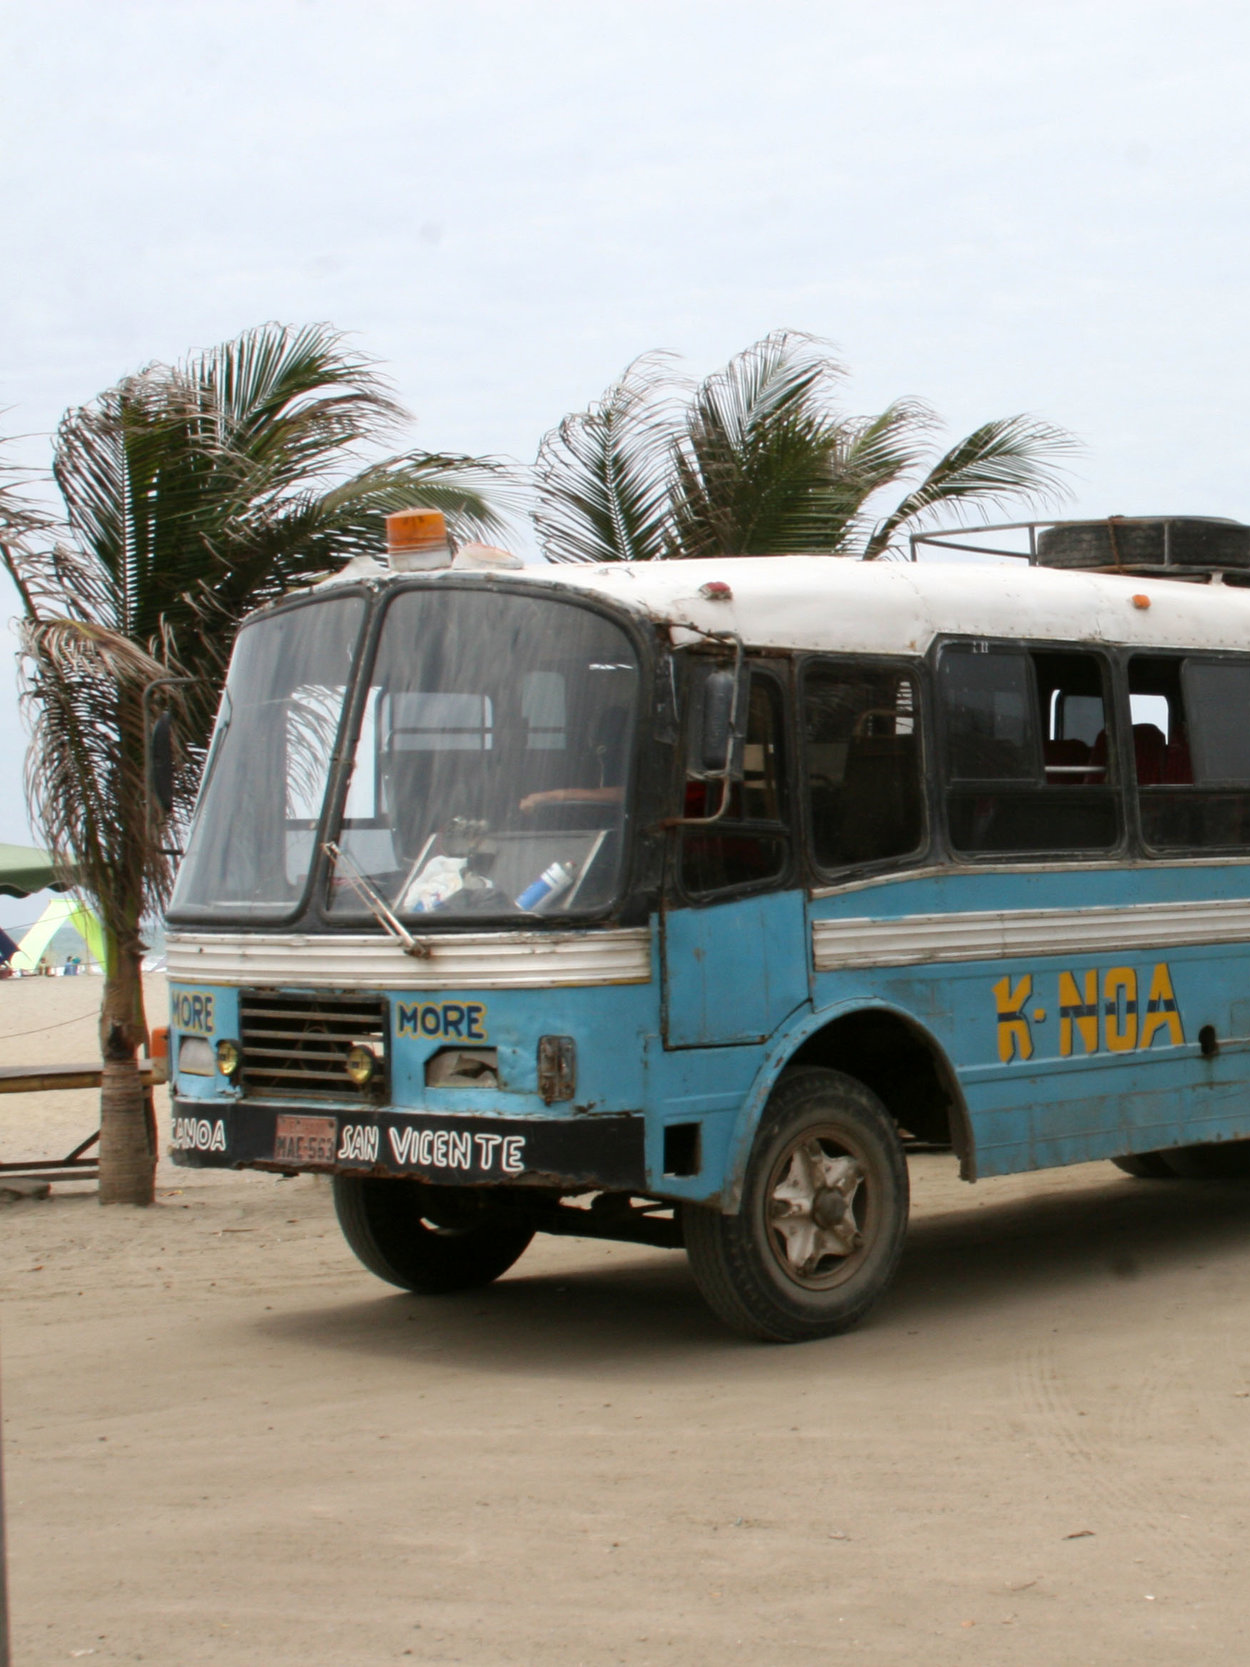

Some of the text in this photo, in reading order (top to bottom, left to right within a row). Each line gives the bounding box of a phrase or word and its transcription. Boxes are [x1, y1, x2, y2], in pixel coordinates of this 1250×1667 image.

[172, 991, 215, 1034] MORE
[397, 1002, 487, 1043] MORE
[338, 1124, 526, 1173] SAN VICENTE
